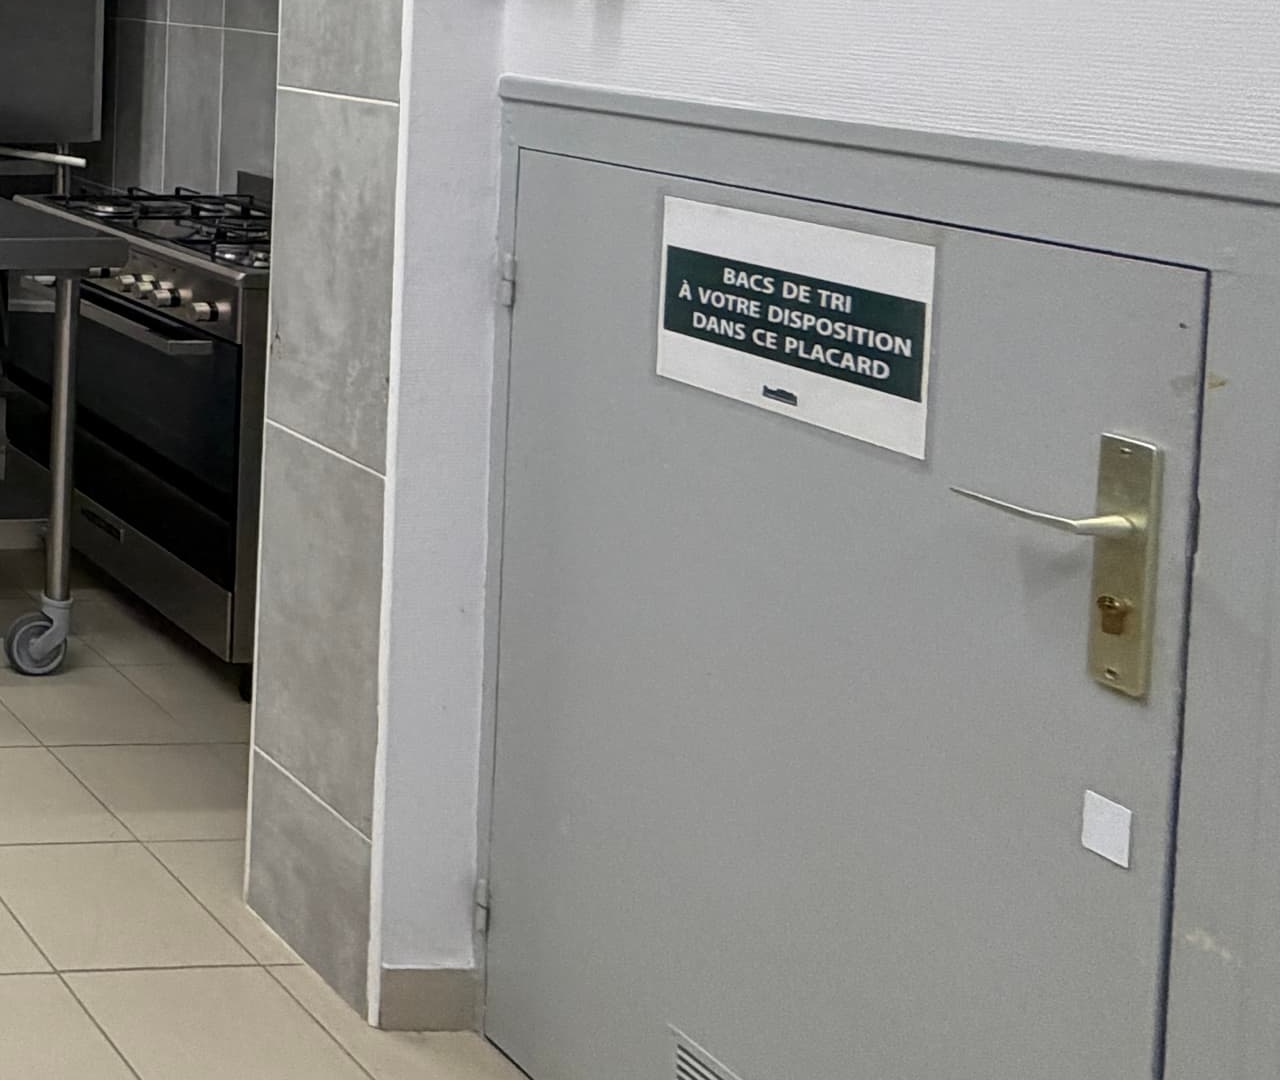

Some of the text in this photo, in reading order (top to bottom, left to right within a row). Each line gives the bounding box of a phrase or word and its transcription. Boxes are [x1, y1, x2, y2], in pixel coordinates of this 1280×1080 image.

[678, 280, 912, 358] À VOTRE DISPOSITION
[723, 267, 852, 314] BACS DE TRI
[692, 312, 890, 380] DANS CE PLACARD
